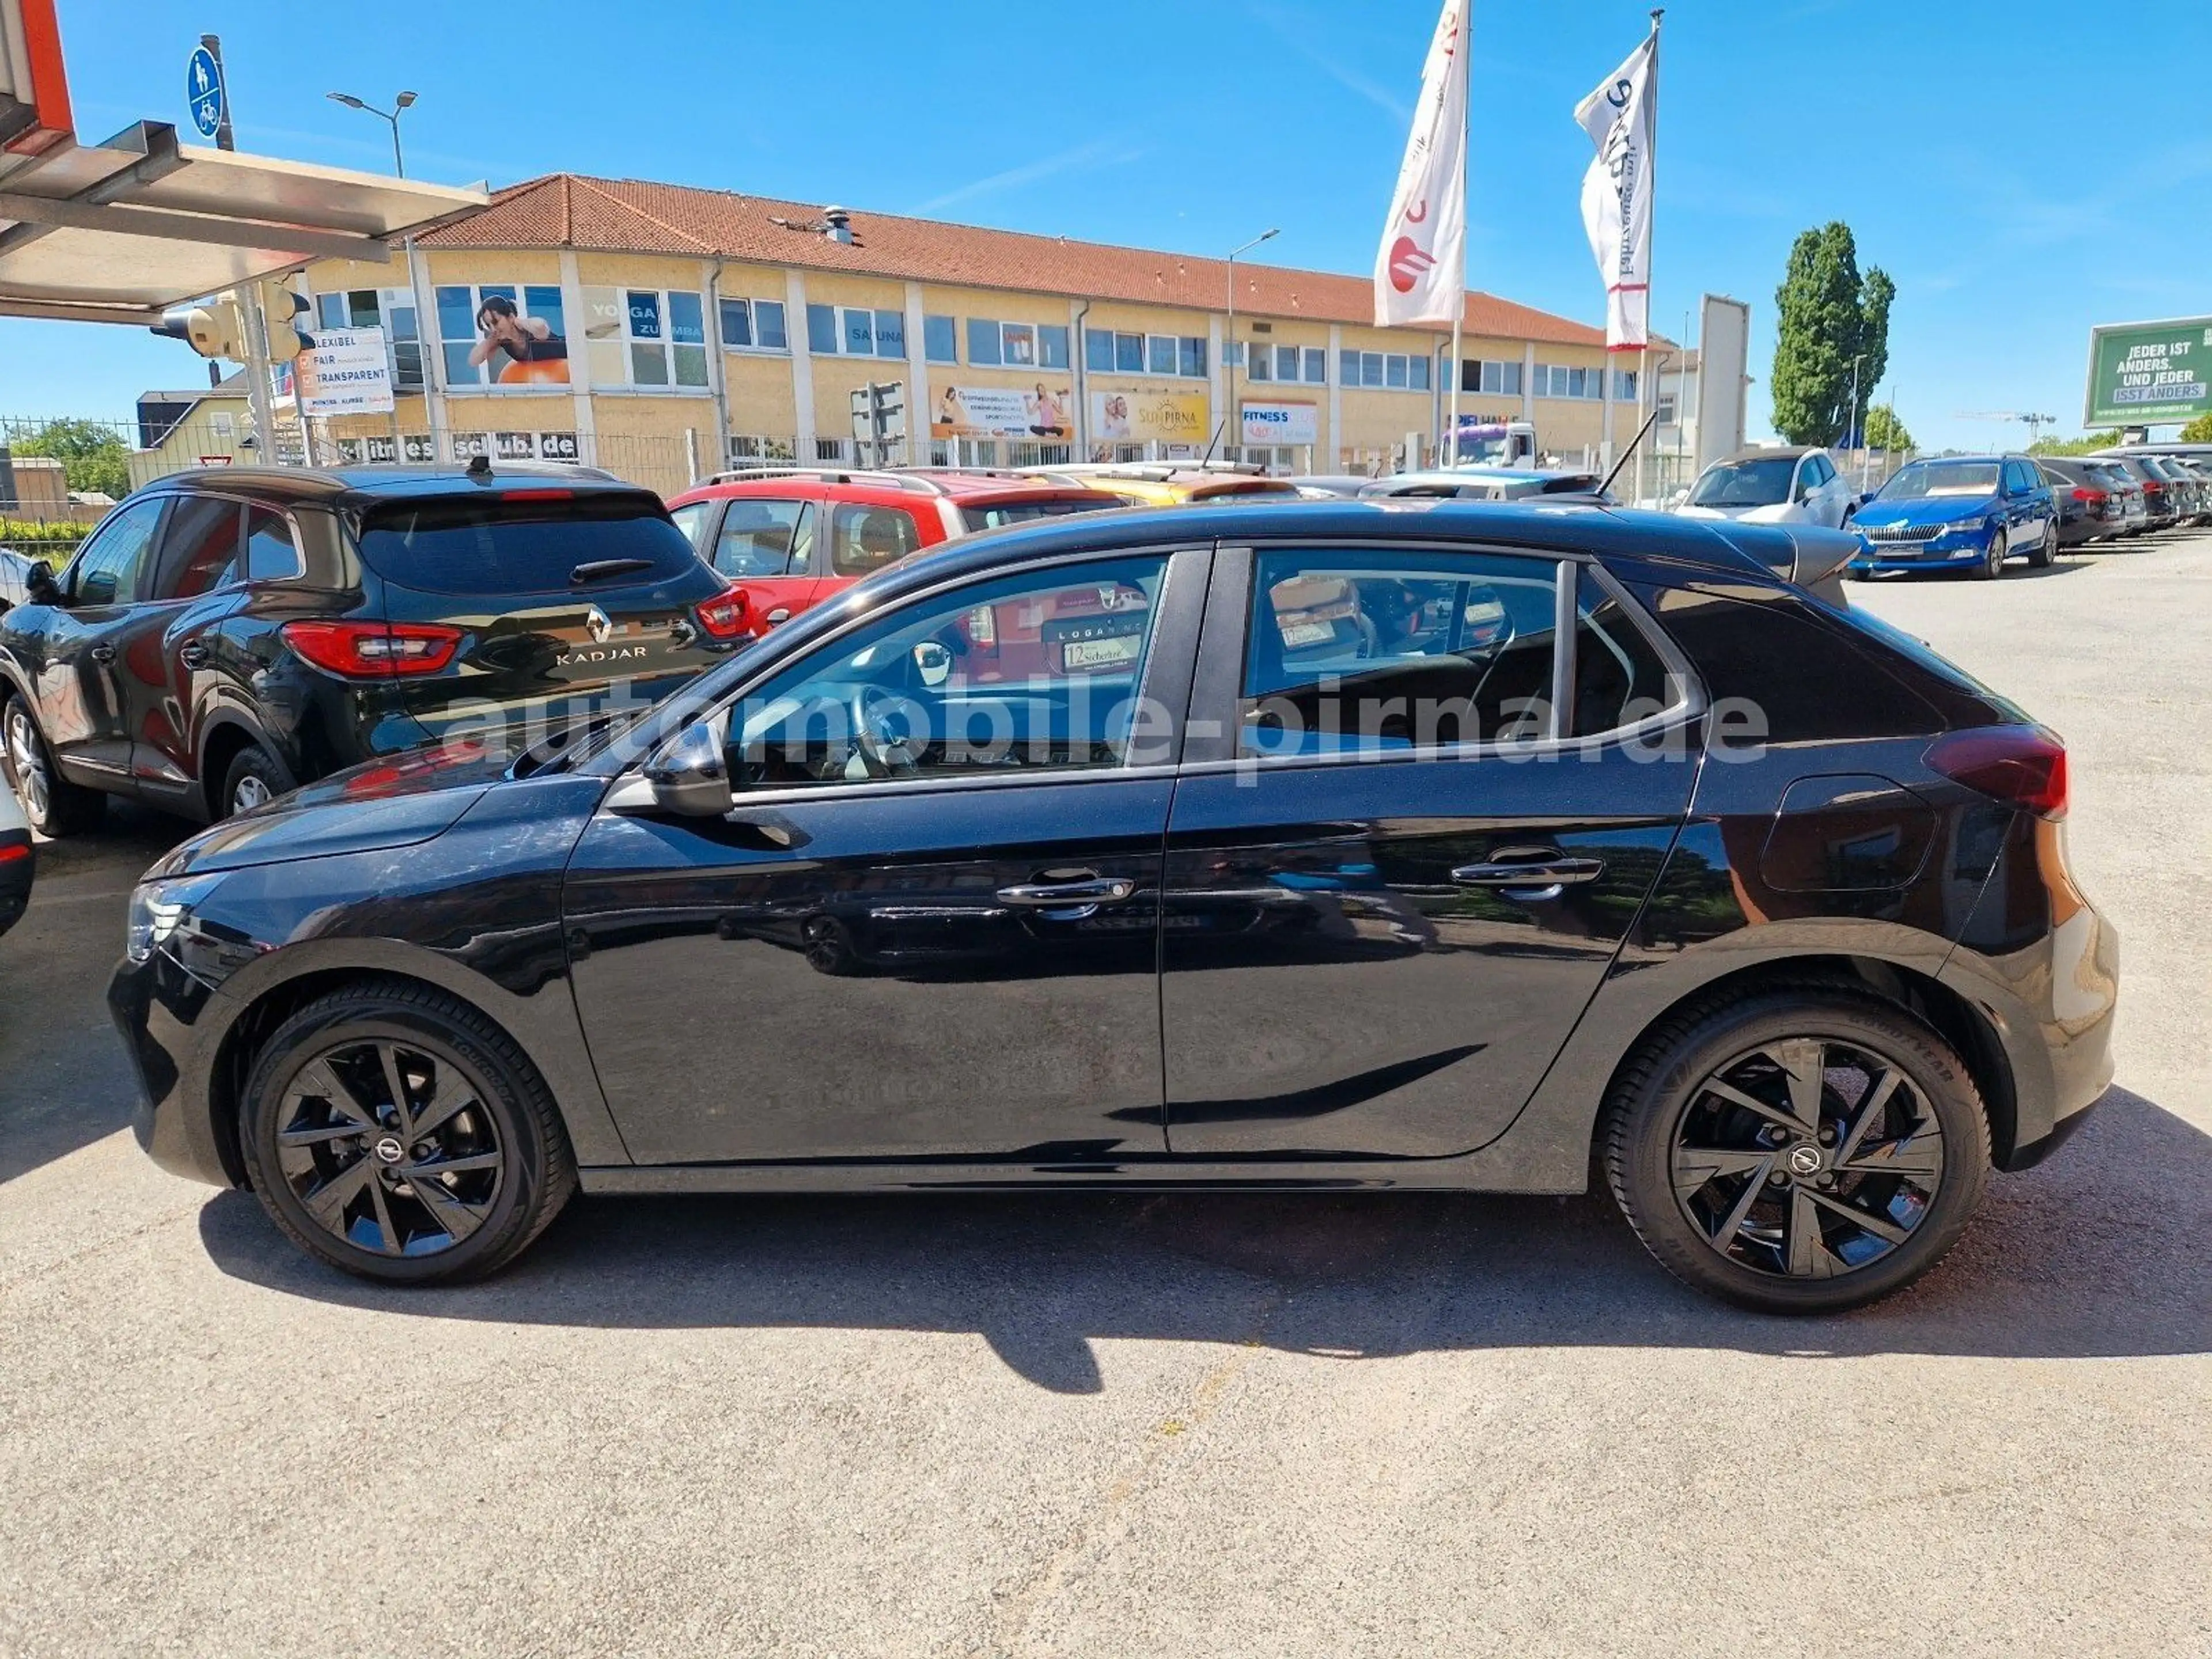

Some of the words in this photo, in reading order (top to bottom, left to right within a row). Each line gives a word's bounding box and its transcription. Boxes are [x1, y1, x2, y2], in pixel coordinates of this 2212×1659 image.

[592, 304, 656, 319] YOGA
[639, 324, 702, 336] ZUMBA
[852, 328, 904, 342] SAUNA
[316, 336, 356, 348] LEXIBEL
[2127, 344, 2166, 359] JEDER
[2169, 342, 2192, 356] IST
[313, 355, 336, 365] FAIR
[2116, 358, 2172, 374] ANDERS.
[316, 369, 385, 384] TRANSPARENT
[2123, 373, 2151, 387] UND
[2153, 370, 2194, 387] JEDER
[2116, 388, 2146, 402] ISST
[2147, 385, 2203, 399] ANDERS.
[1165, 411, 1197, 424] PIRNA
[1244, 411, 1289, 422] FITNESS
[1058, 626, 1116, 639] LOGAN
[556, 646, 647, 666] KADJAR
[1067, 645, 1084, 665] 12
